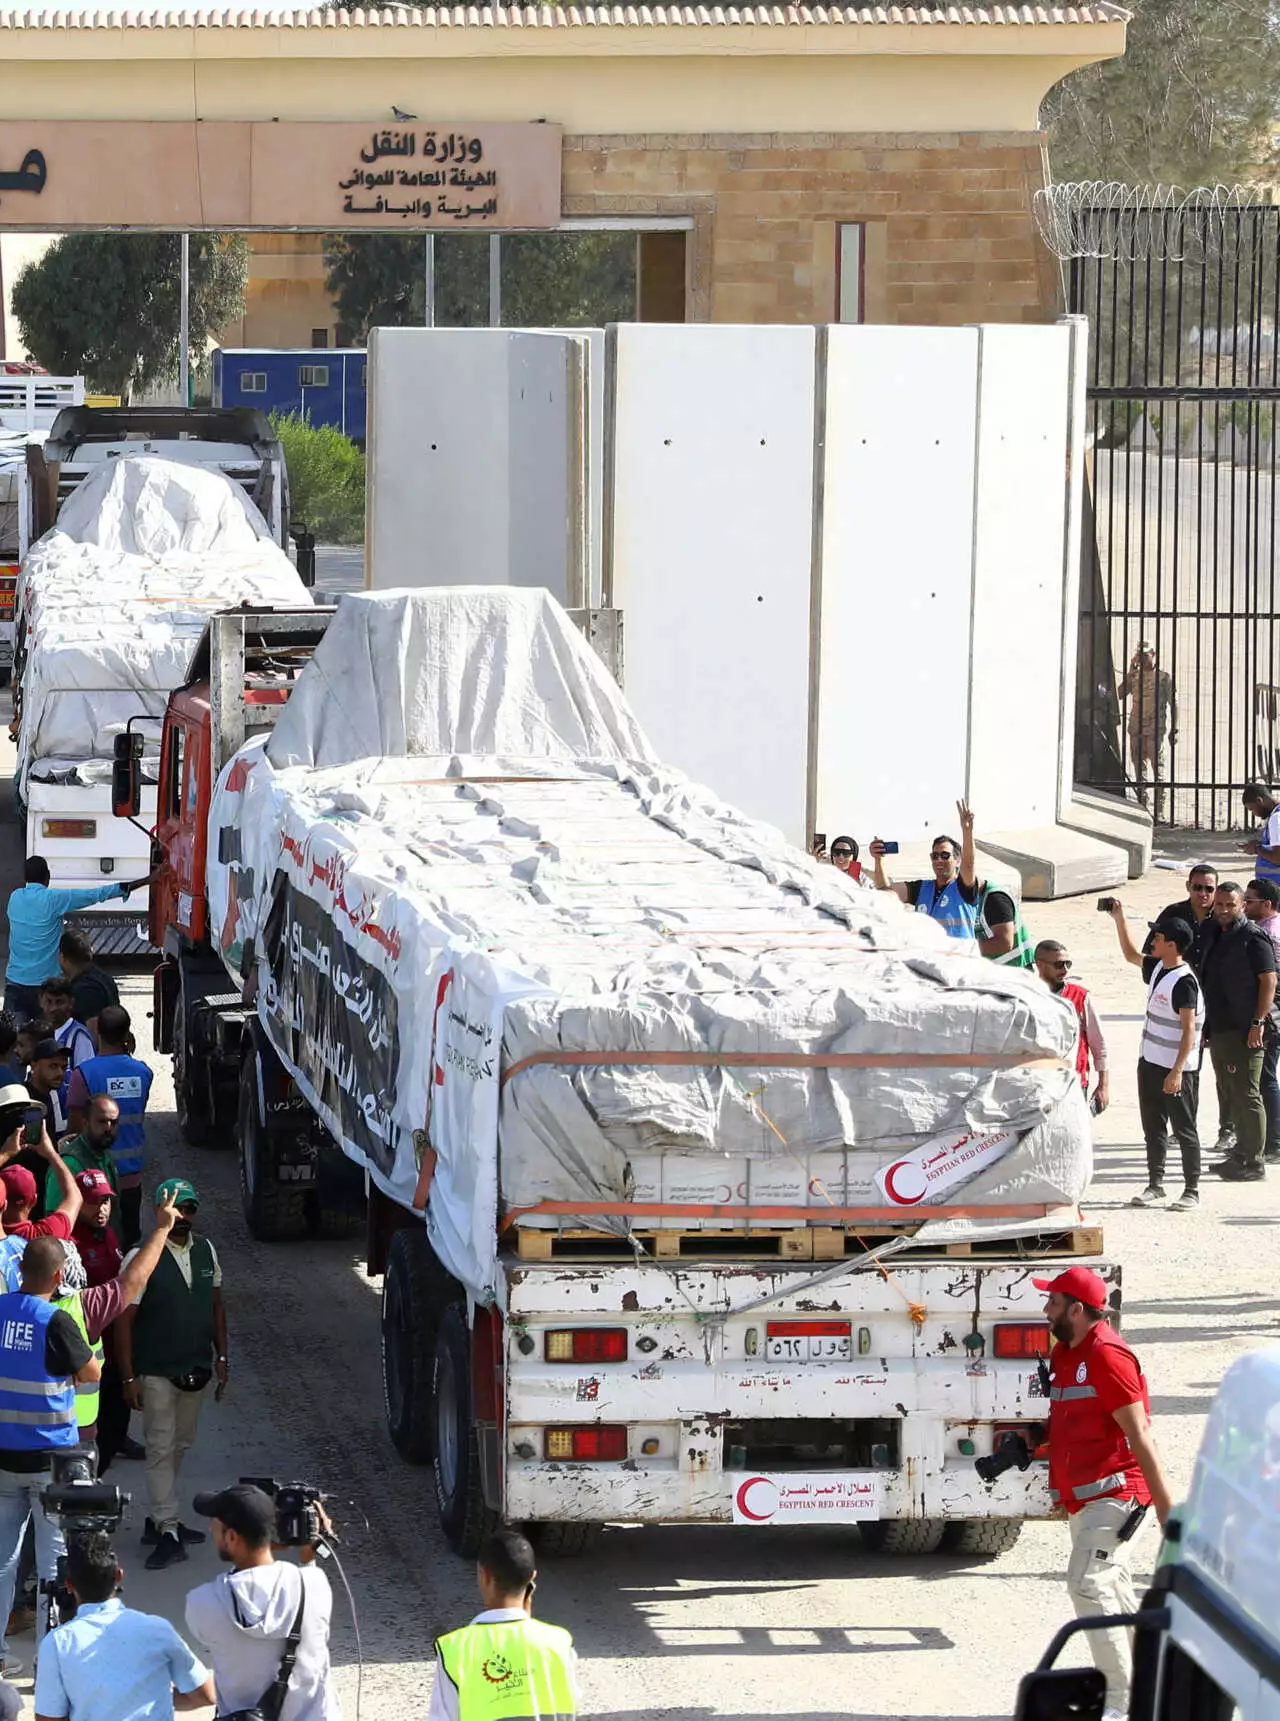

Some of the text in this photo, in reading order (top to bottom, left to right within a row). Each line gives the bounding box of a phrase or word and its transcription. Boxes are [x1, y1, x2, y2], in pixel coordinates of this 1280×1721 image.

[360, 131, 483, 164] وزارة النقل
[396, 169, 446, 186] العامة
[449, 168, 496, 191] الهيئة
[438, 195, 498, 219] البرية
[926, 1132, 1010, 1181] EGYPTIAN RED CRESCENT
[774, 1340, 801, 1357] ٥٦٢
[847, 1482, 875, 1496] الهلال
[779, 1499, 875, 1509] EGYPTIAN RED CRESCENT
